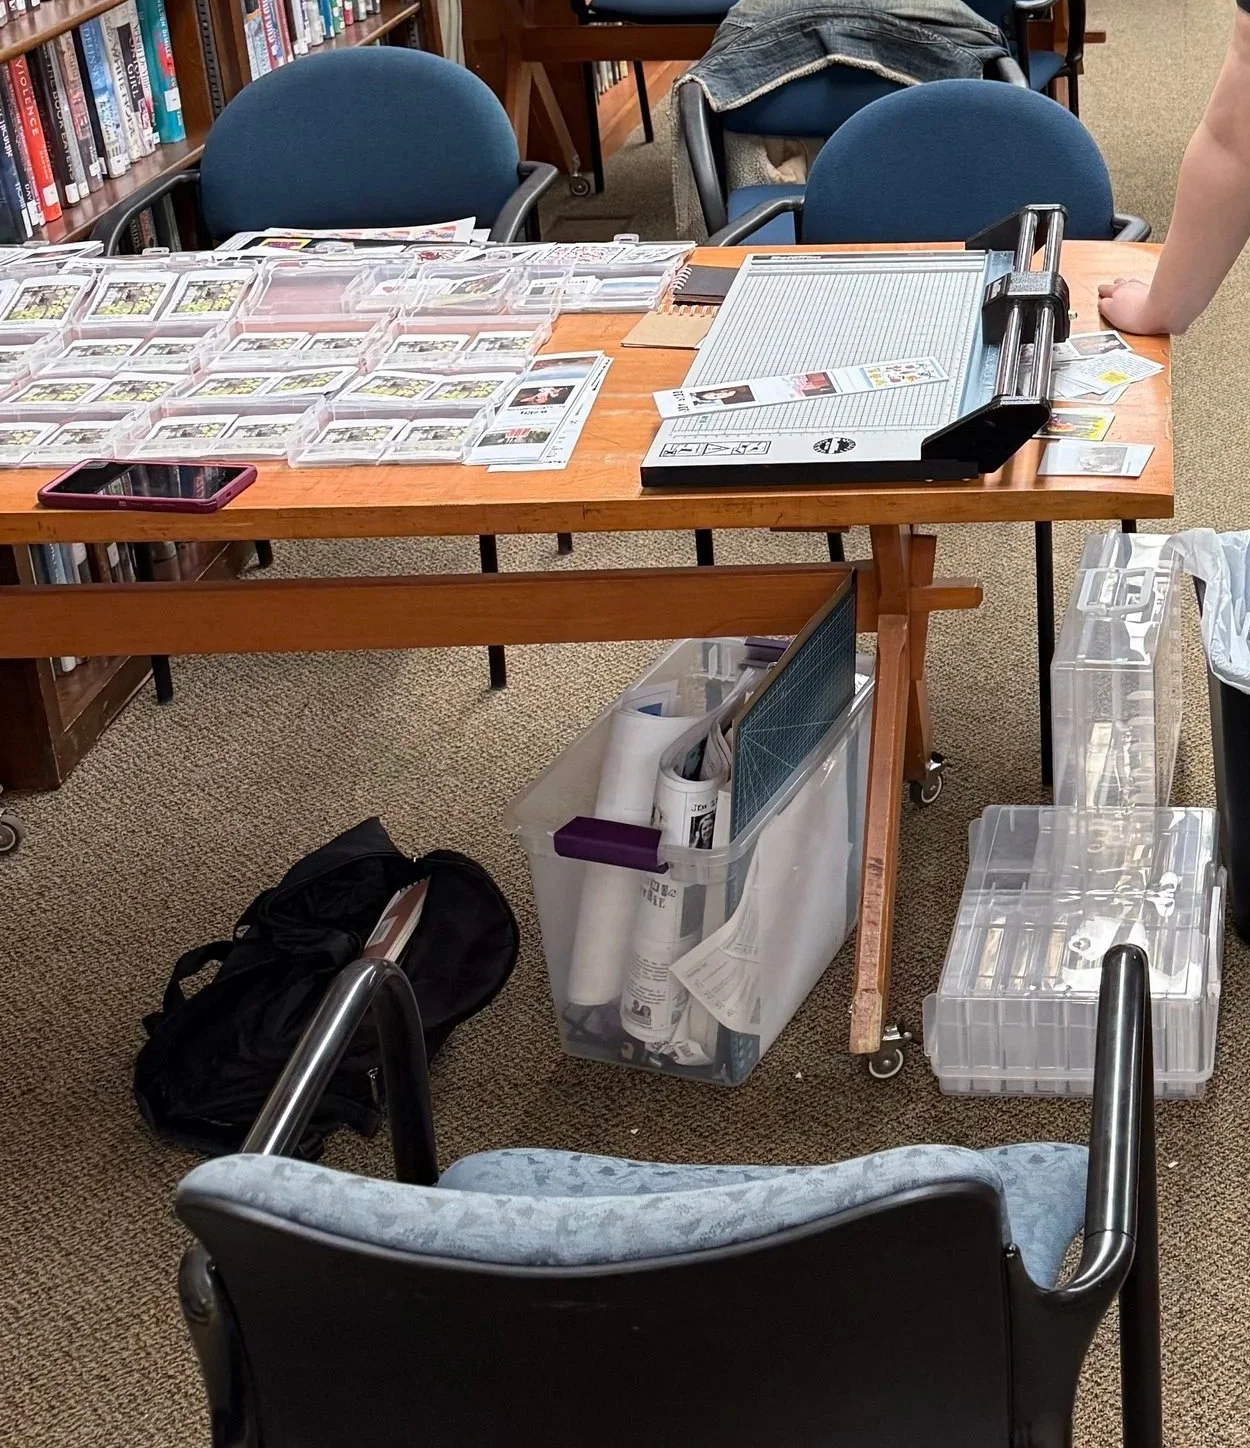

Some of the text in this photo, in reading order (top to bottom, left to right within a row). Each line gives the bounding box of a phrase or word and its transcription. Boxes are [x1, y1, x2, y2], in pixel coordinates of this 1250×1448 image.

[81, 27, 102, 85] DELINSKY
[108, 43, 137, 138] WHITE NOISE
[126, 62, 138, 98] GIRL
[13, 58, 41, 136] VIOLENCE
[50, 90, 66, 129] BOOK
[58, 131, 77, 180] EATERS
